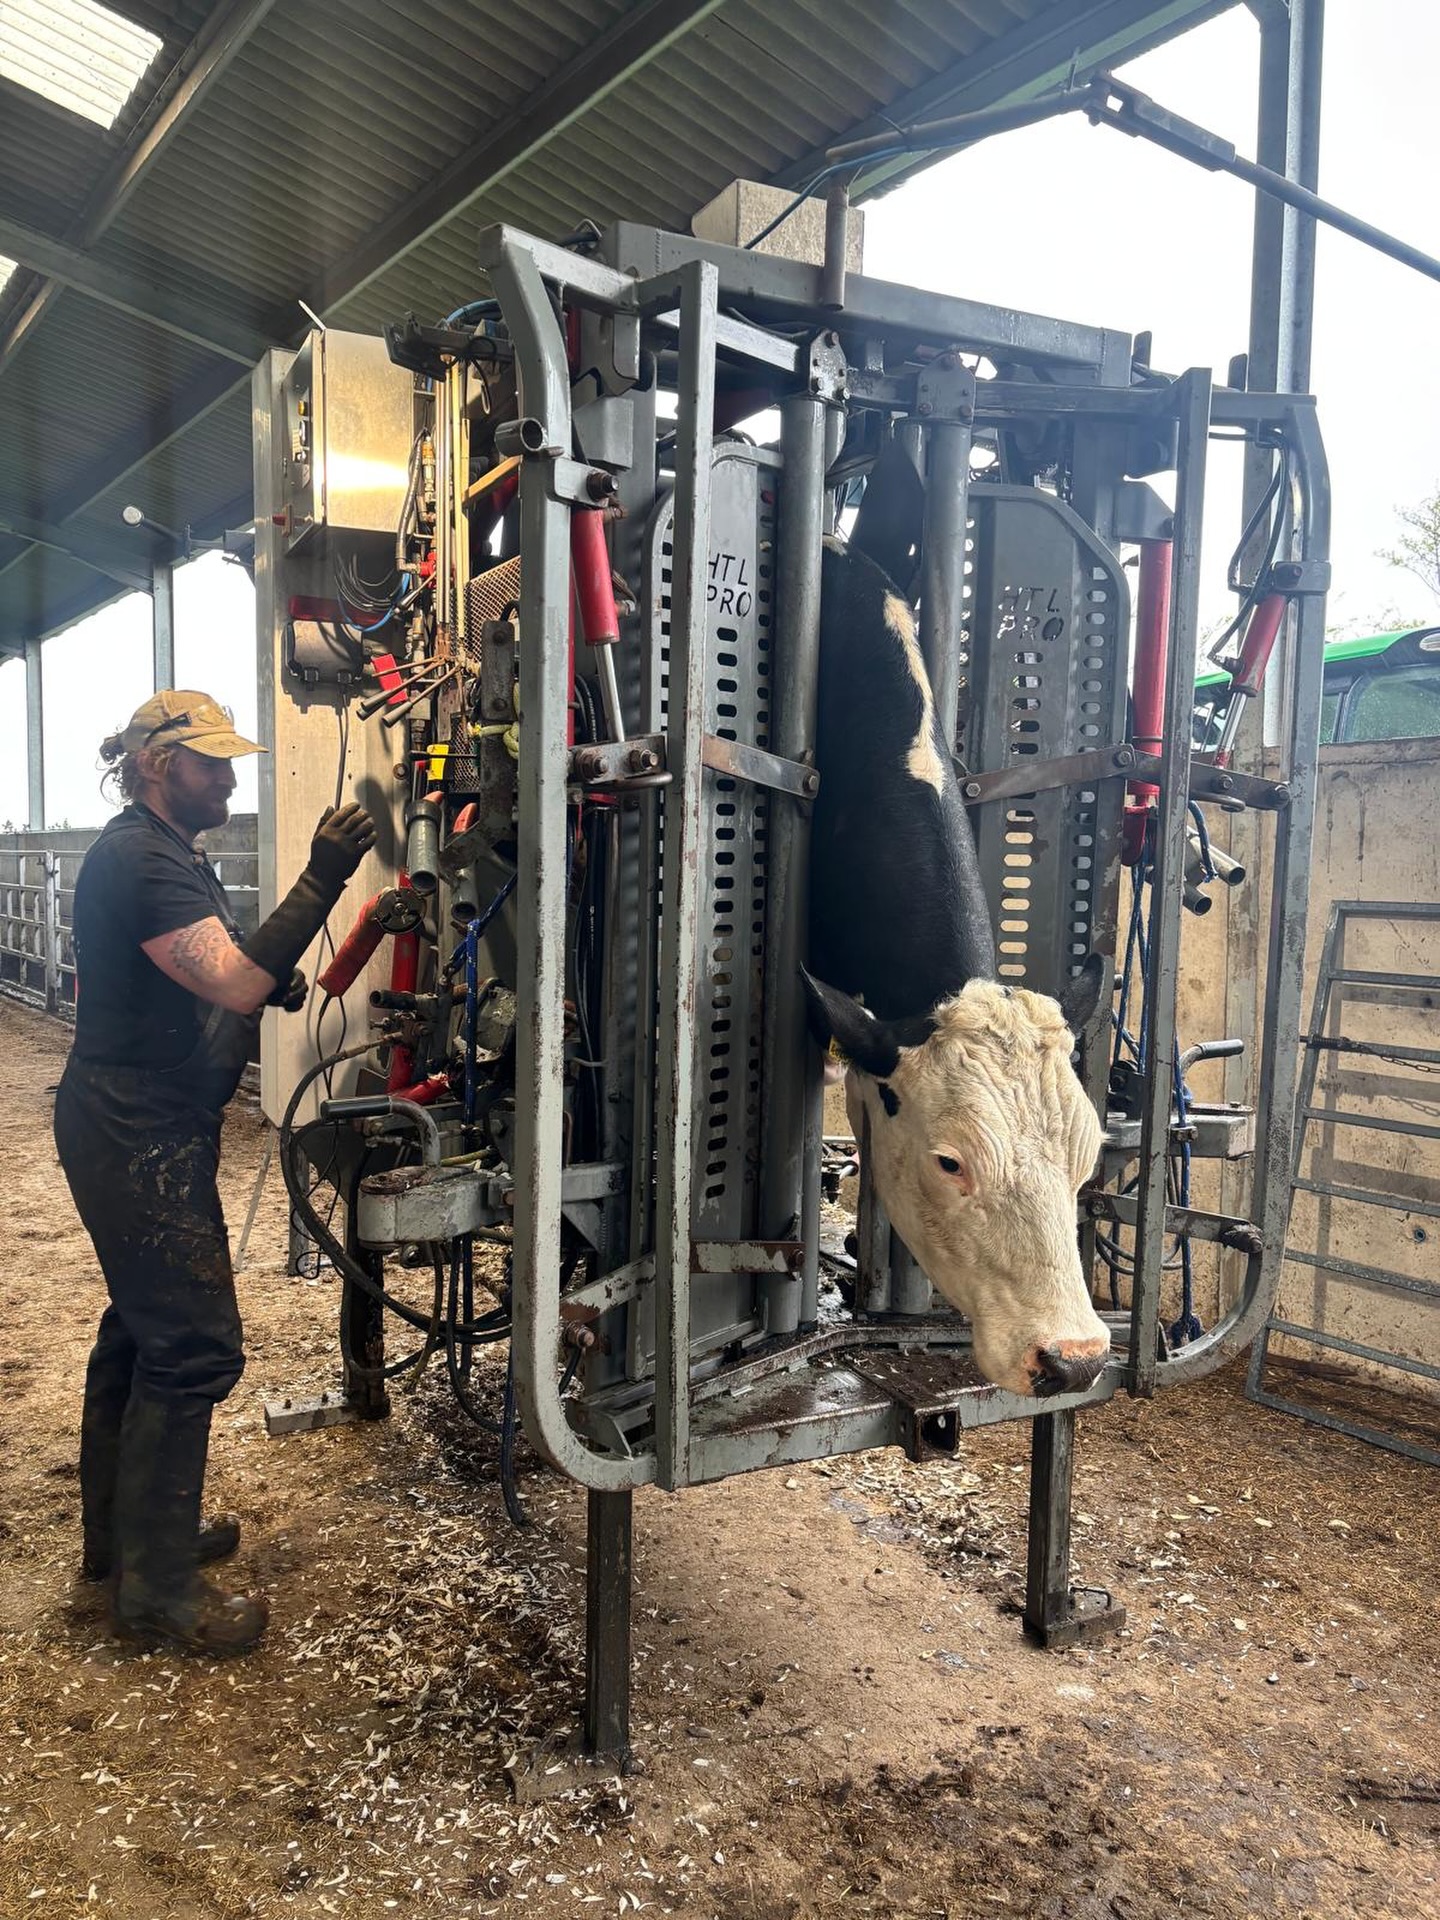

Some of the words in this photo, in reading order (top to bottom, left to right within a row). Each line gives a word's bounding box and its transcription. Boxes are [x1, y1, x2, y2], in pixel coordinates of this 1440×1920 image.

[708, 553, 748, 586] HTL
[707, 584, 752, 617] PRO
[998, 586, 1060, 612] HTL
[997, 615, 1064, 641] PRO
